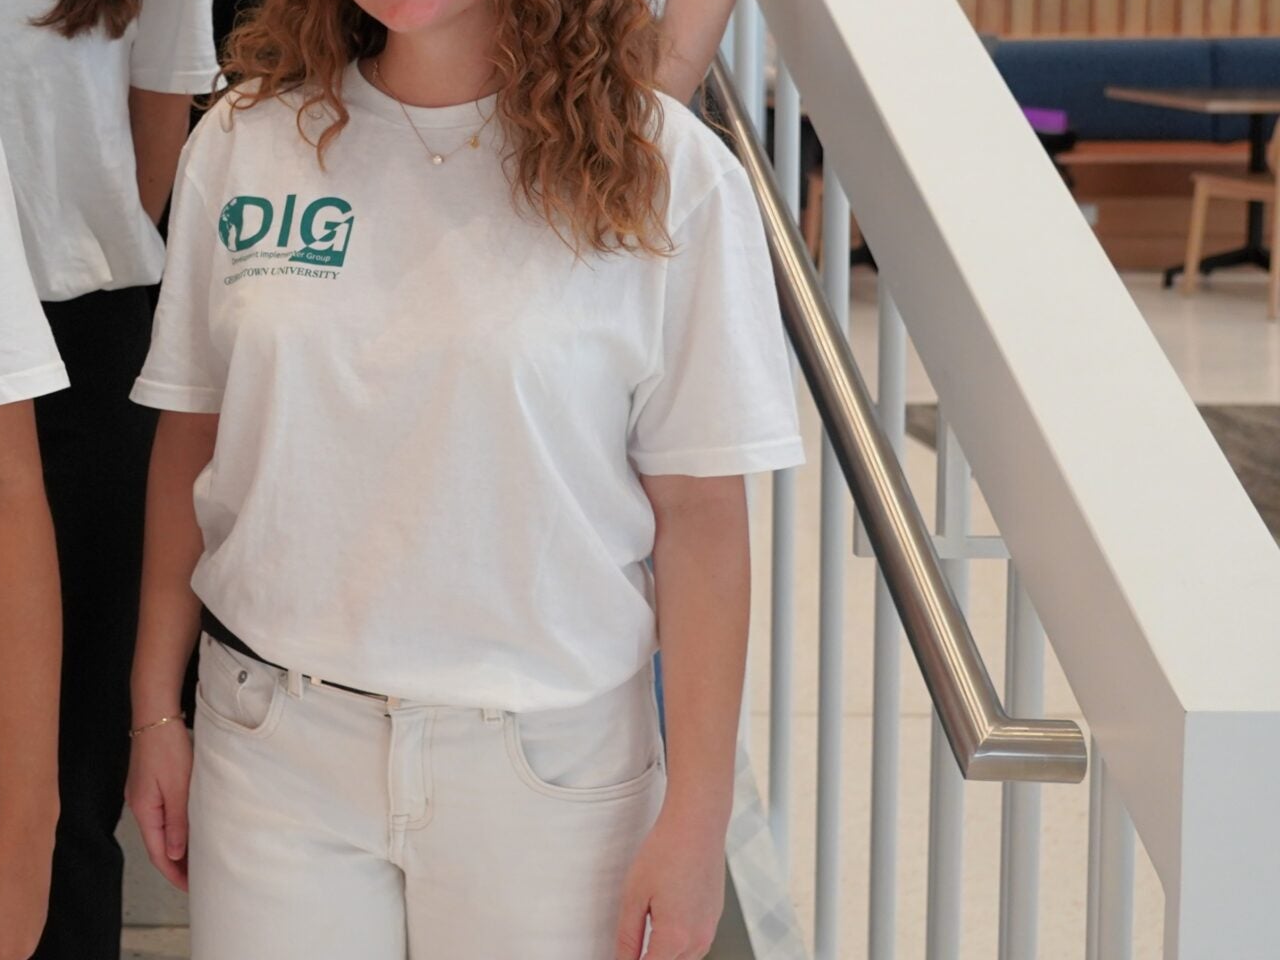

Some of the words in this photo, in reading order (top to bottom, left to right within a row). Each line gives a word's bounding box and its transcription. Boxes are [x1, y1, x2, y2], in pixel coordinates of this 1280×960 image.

[218, 194, 354, 257] DIG
[306, 252, 332, 264] Group
[271, 266, 340, 280] UNIVERSITY
